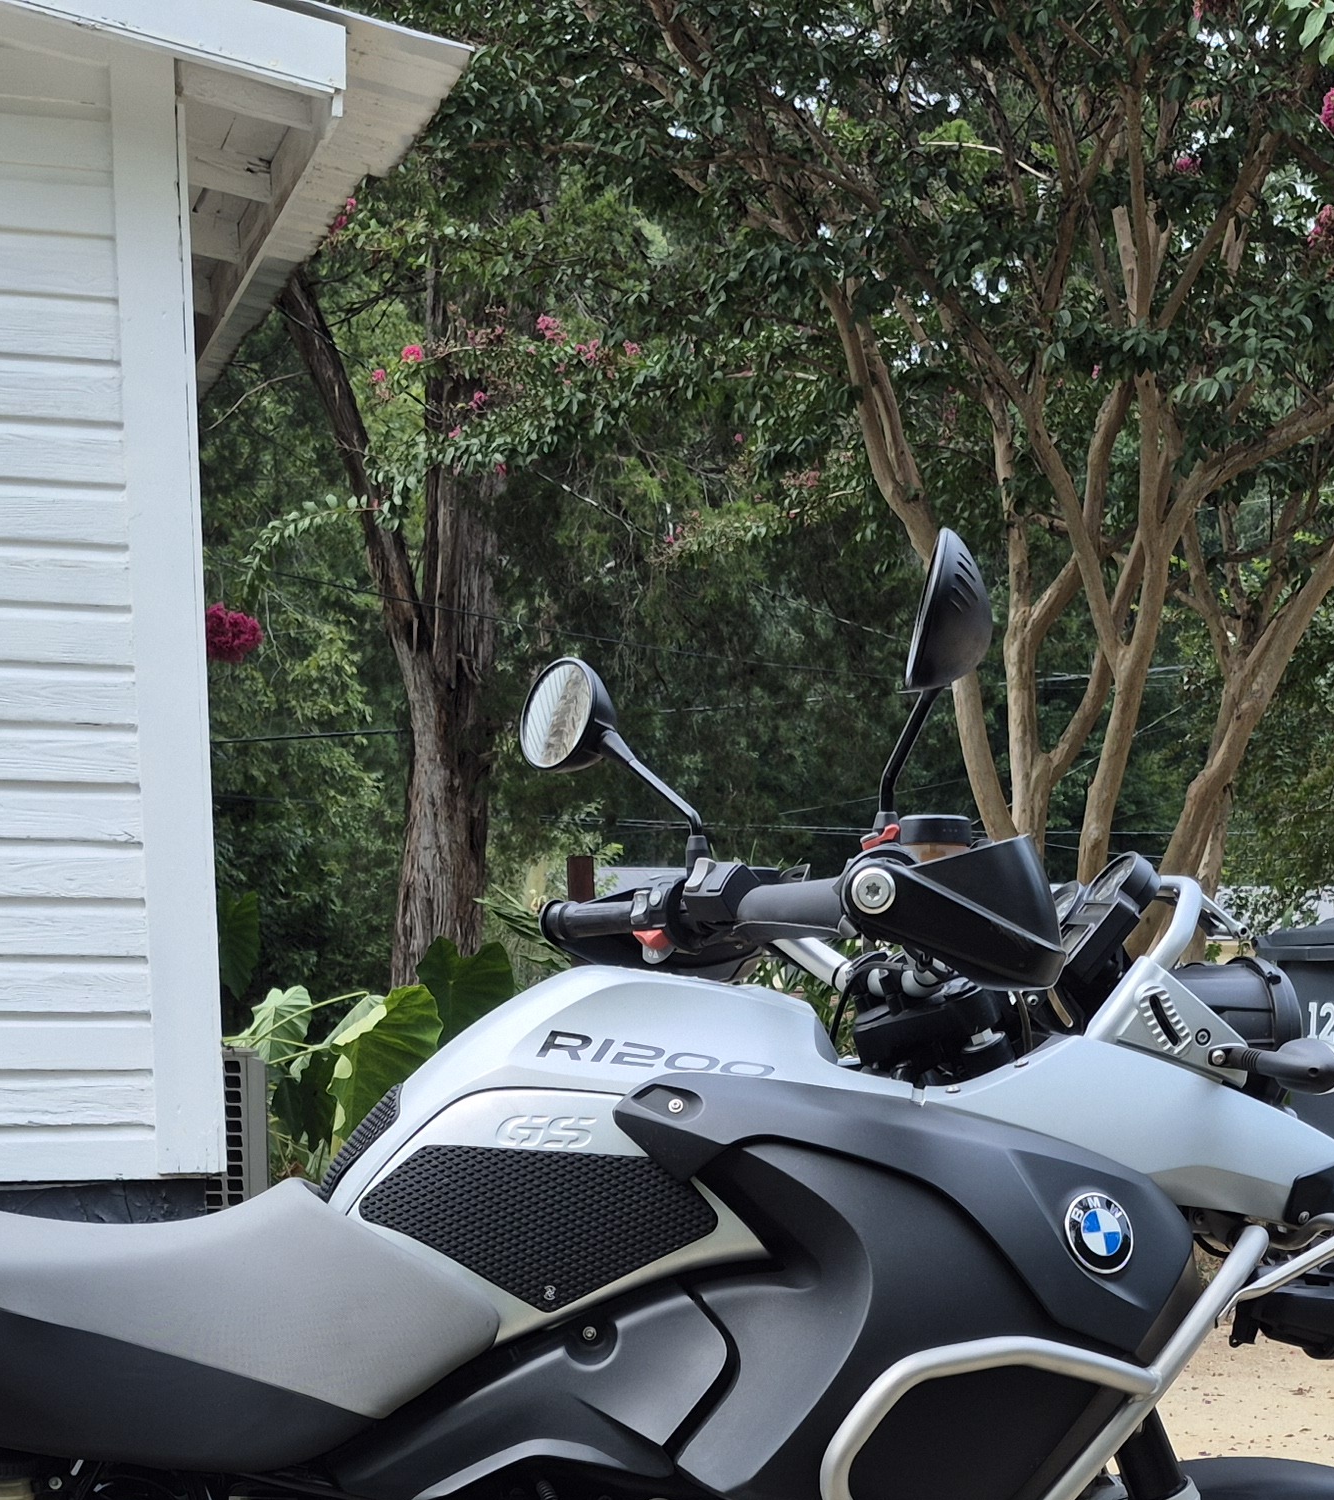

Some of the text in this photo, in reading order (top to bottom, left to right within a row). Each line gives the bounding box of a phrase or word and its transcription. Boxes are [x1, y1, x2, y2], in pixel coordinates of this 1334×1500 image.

[535, 1030, 776, 1077] R1200
[495, 1112, 599, 1150] GS
[1070, 1196, 1124, 1222] BMW
